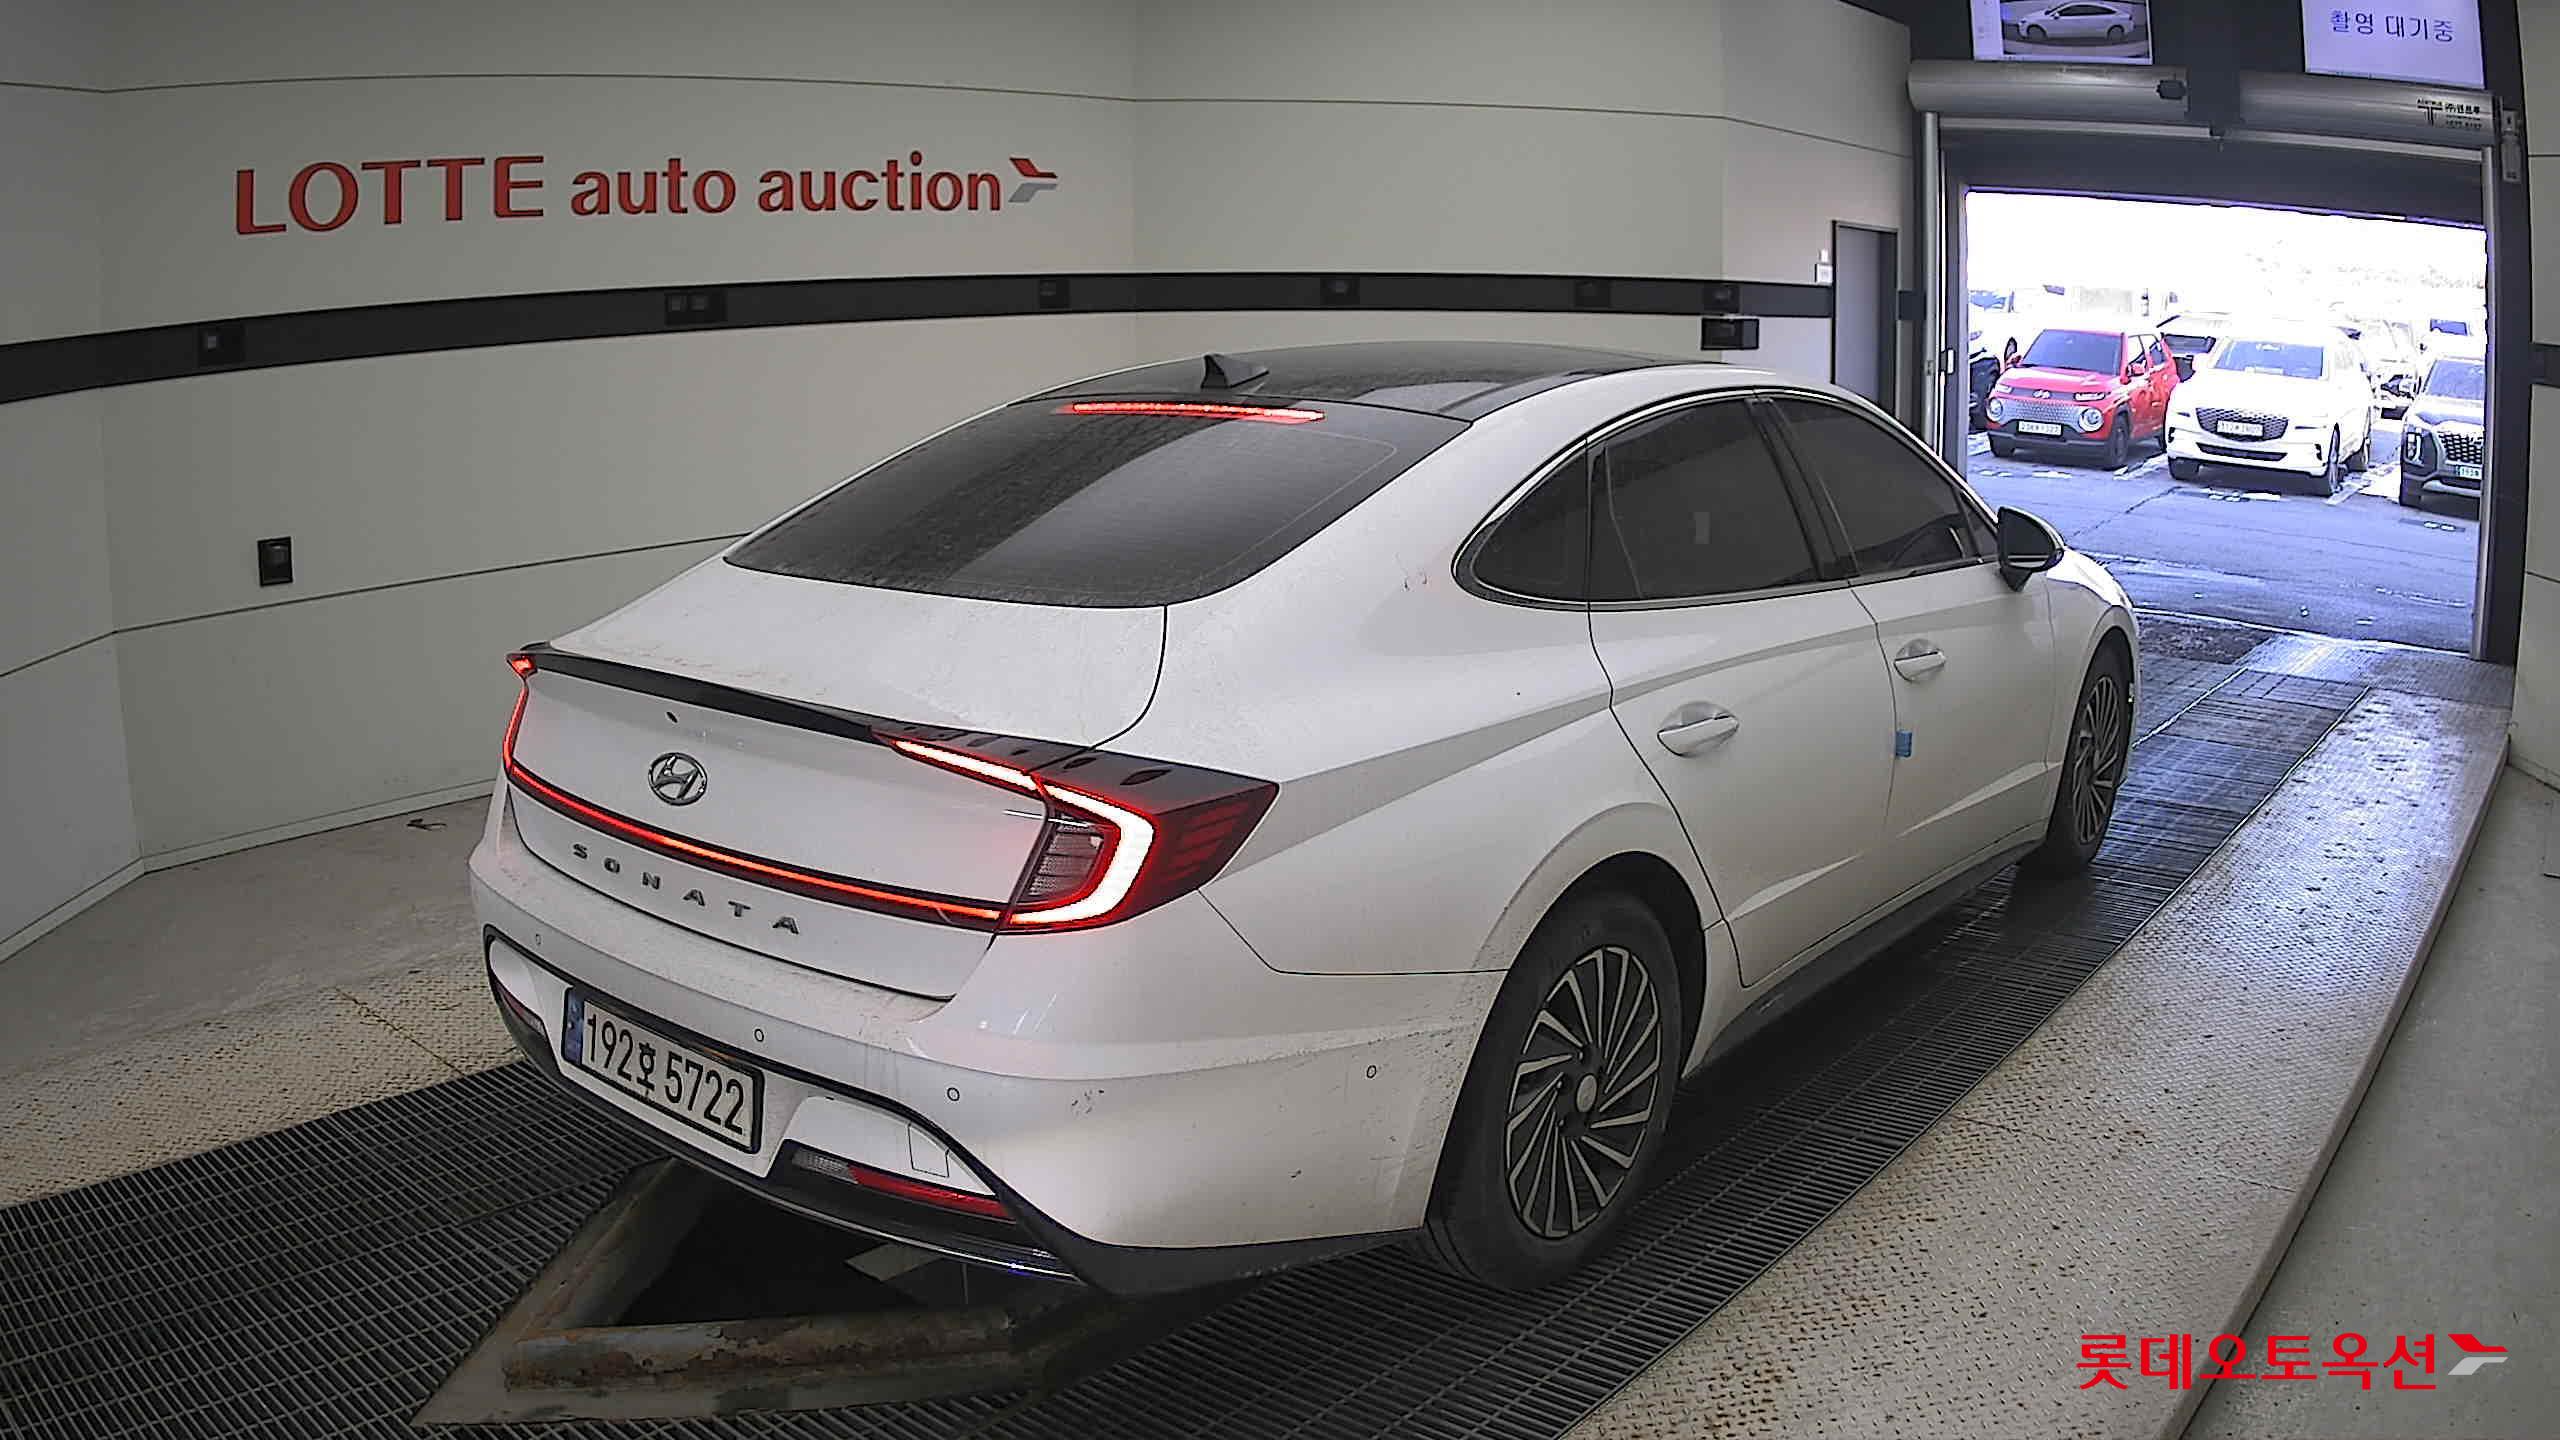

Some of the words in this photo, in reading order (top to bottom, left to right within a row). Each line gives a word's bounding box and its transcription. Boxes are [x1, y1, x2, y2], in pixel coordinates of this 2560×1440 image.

[2331, 10, 2374, 35] 촬영
[2386, 15, 2453, 42] 대기중
[236, 155, 544, 235] LOTTE
[570, 157, 737, 215] auto
[757, 150, 1001, 213] auction
[572, 842, 800, 936] SONATA
[664, 1050, 744, 1136] 5722
